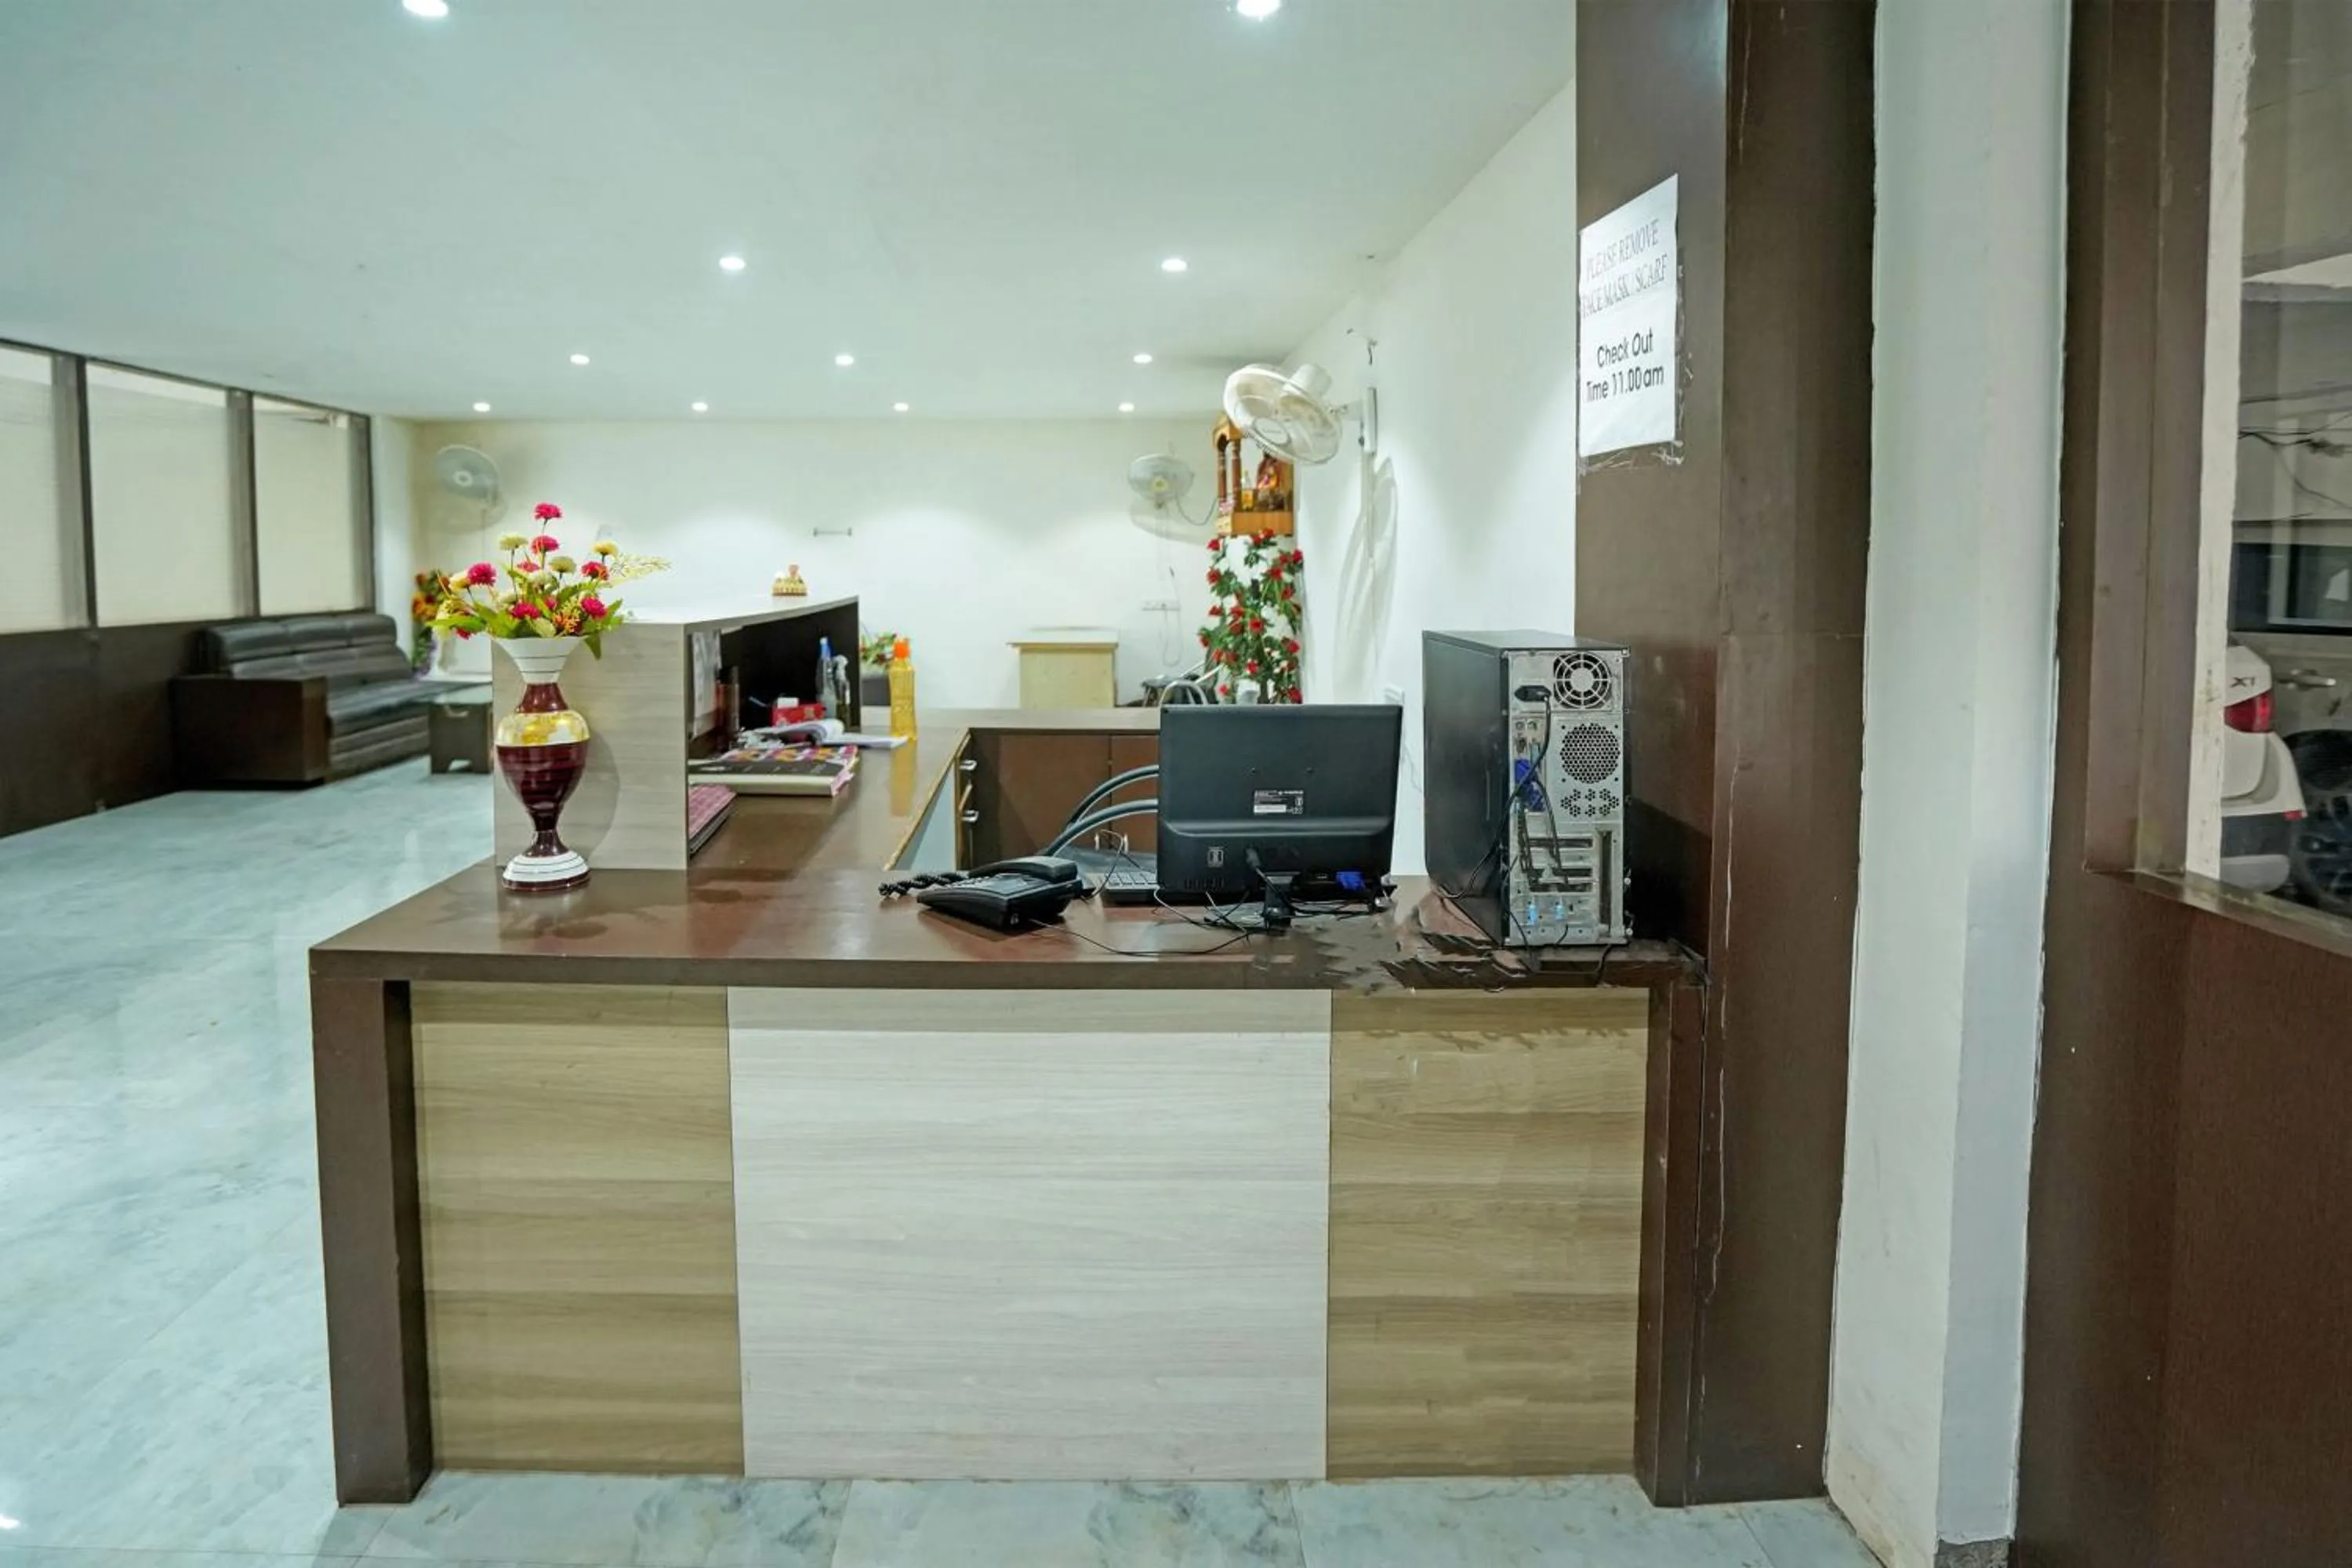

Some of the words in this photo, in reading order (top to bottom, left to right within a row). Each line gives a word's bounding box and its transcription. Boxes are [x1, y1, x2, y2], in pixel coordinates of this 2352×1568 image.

[1586, 241, 1617, 281] PLEASE
[1619, 218, 1660, 264] REMOVE
[1603, 273, 1631, 307] MASK
[1635, 252, 1668, 292] SCARF
[1596, 336, 1630, 368] Check
[1632, 325, 1653, 358] Out
